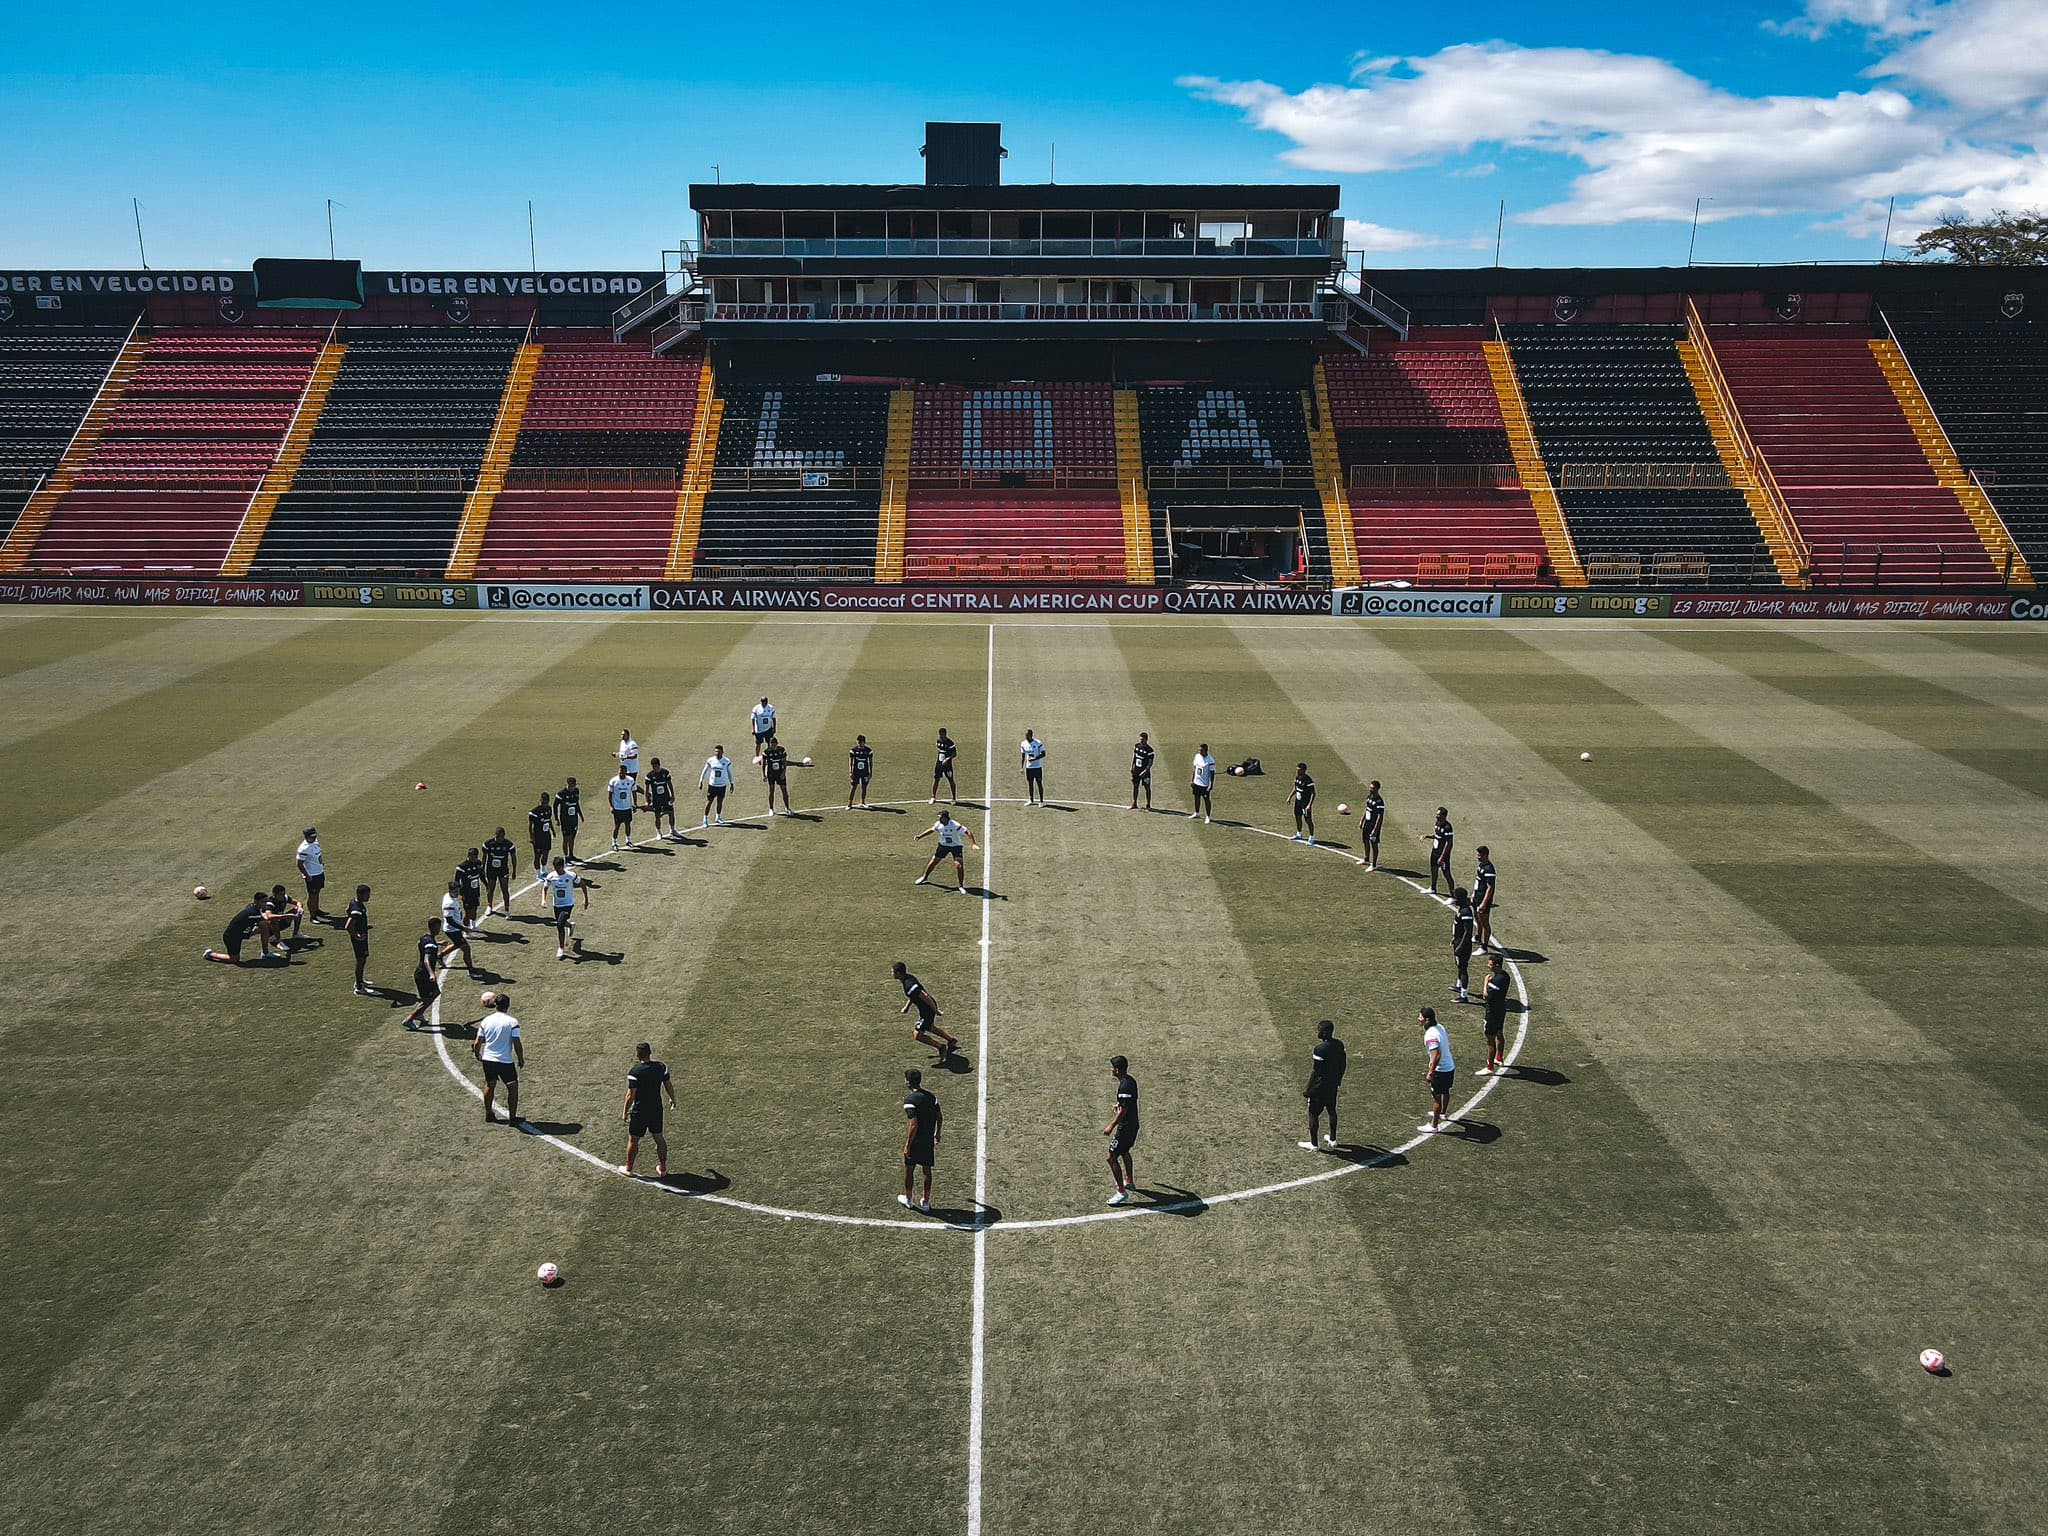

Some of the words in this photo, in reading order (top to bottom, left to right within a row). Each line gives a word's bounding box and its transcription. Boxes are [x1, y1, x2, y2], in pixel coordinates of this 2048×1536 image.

[51, 276, 83, 291] EN
[89, 276, 234, 292] VELOCIDAD
[388, 273, 459, 293] LÍDER
[464, 277, 497, 293] EN
[503, 277, 643, 294] VELOCIDAD
[0, 584, 28, 602] ICIL
[31, 585, 73, 601] JUGAR
[115, 584, 140, 601] AUN
[144, 587, 171, 602] MAS
[176, 586, 222, 603] DIFICIL
[225, 585, 266, 602] GANAR
[270, 588, 301, 602] AQUI
[314, 586, 385, 605] monge
[395, 587, 467, 606] monge
[512, 588, 643, 609] @concacaf
[653, 589, 724, 608] QATAR
[730, 589, 821, 607] AIRWAYS
[823, 592, 906, 608] Concacaf
[911, 593, 1003, 609] CENTRAL
[1009, 593, 1113, 609] AMERICAN
[1118, 593, 1160, 610] CUP
[1164, 592, 1236, 610] QATAR
[1241, 592, 1332, 610] AIRWAYS
[1365, 594, 1495, 615] @concacaf
[1510, 595, 1579, 615] monge
[1590, 595, 1661, 615] monge
[1673, 600, 1693, 613] ES
[1696, 599, 1742, 616] DIFICIL
[1743, 600, 1785, 615] JUGAR
[1825, 599, 1851, 614] AUN
[1853, 601, 1880, 616] MAS
[1883, 600, 1930, 617] DIFICIL
[1931, 598, 1973, 616] GANAR
[1975, 602, 2008, 616] AQUI
